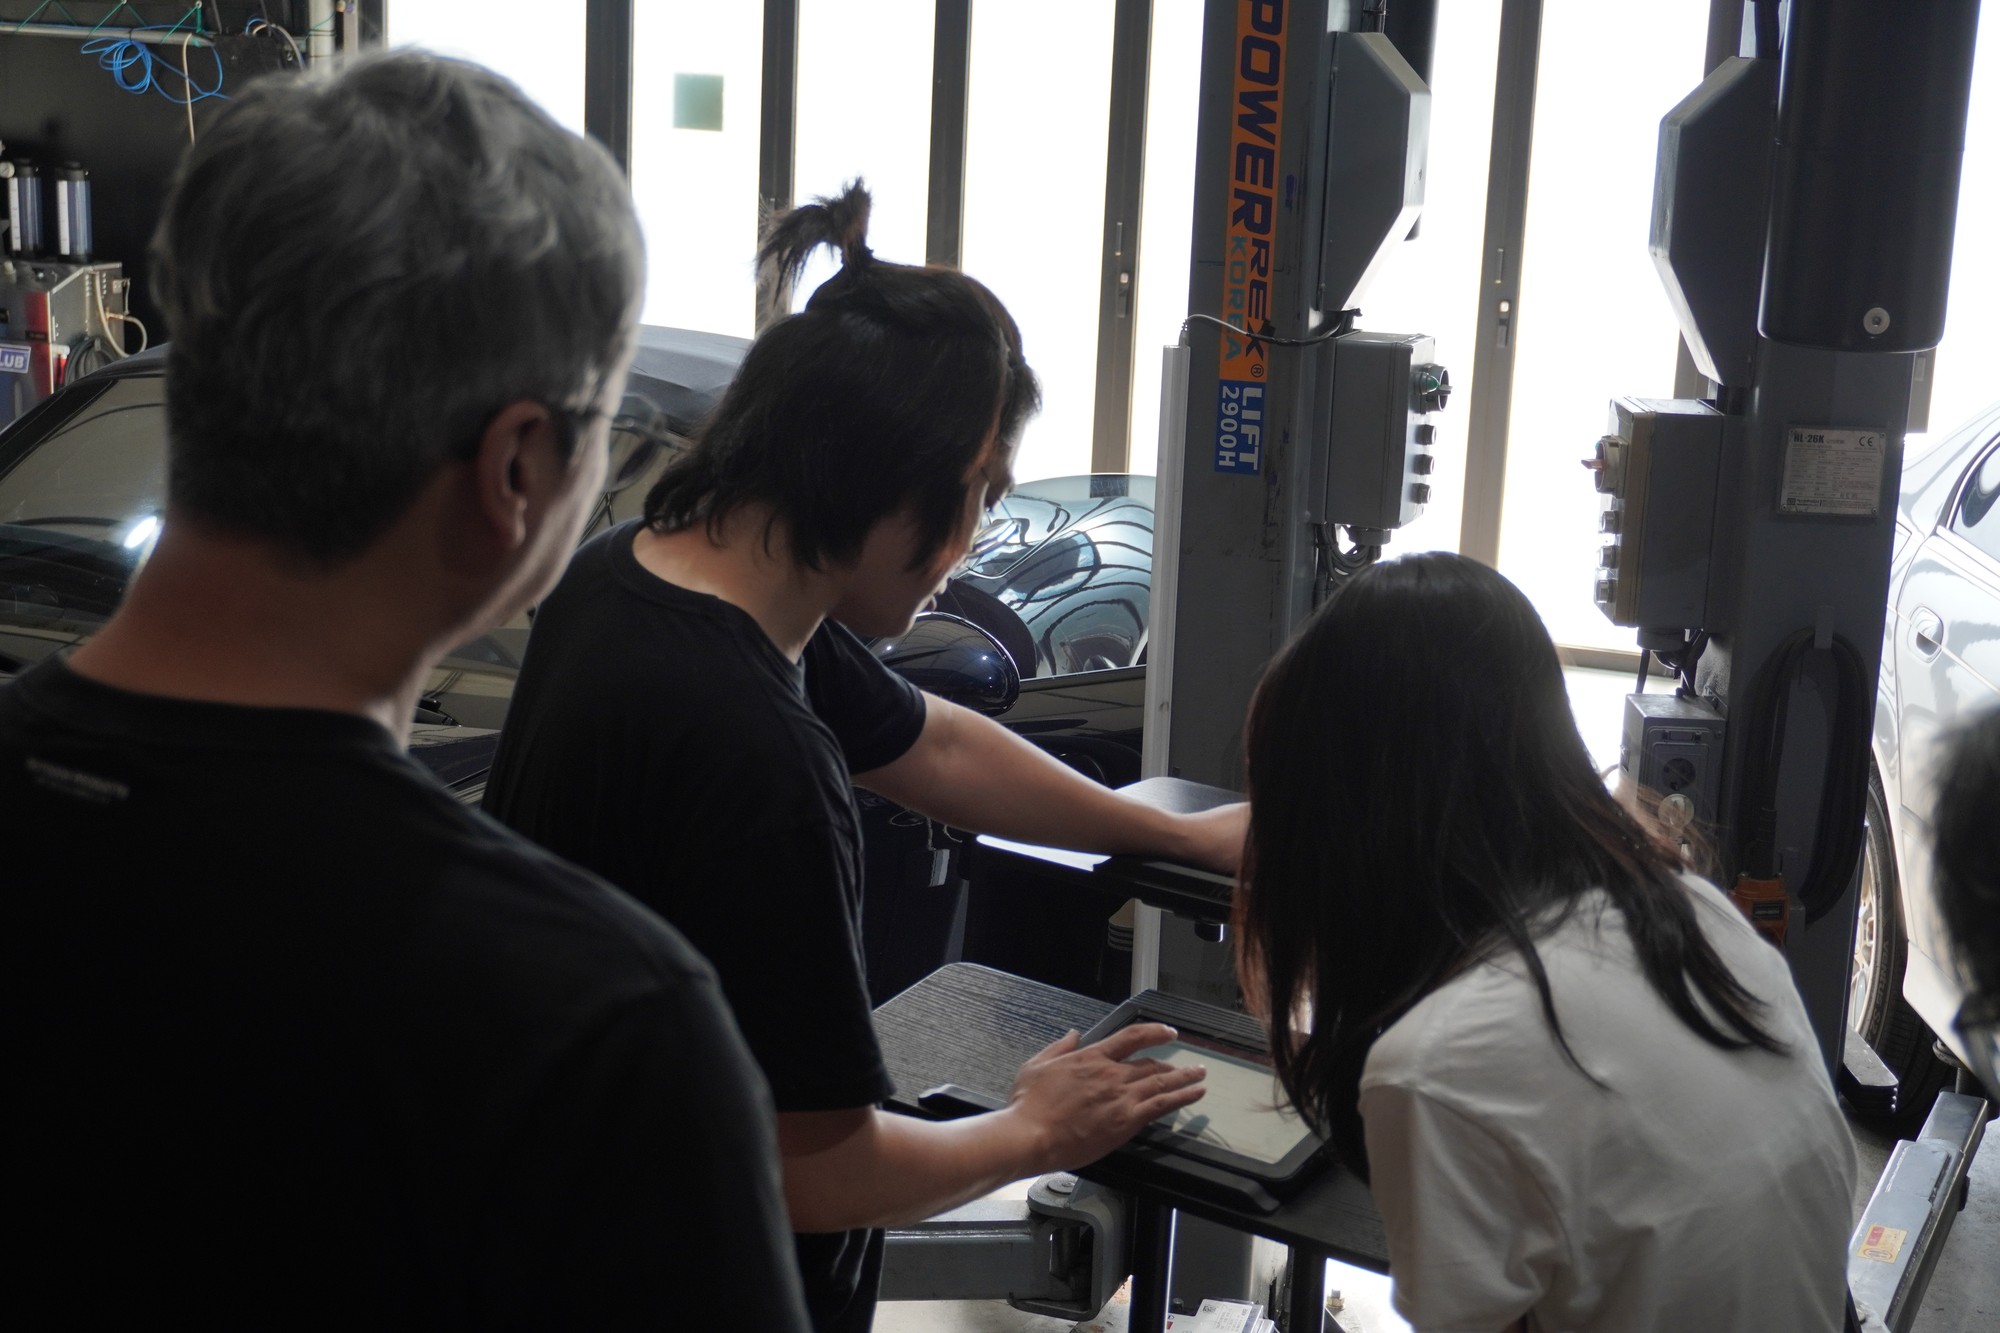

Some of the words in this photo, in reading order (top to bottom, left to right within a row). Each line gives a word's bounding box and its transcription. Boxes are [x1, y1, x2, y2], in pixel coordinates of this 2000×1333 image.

[1224, 236, 1246, 361] KOREA
[1217, 385, 1240, 468] 2900H
[1239, 386, 1263, 471] LIFT
[1858, 436, 1875, 447] CE
